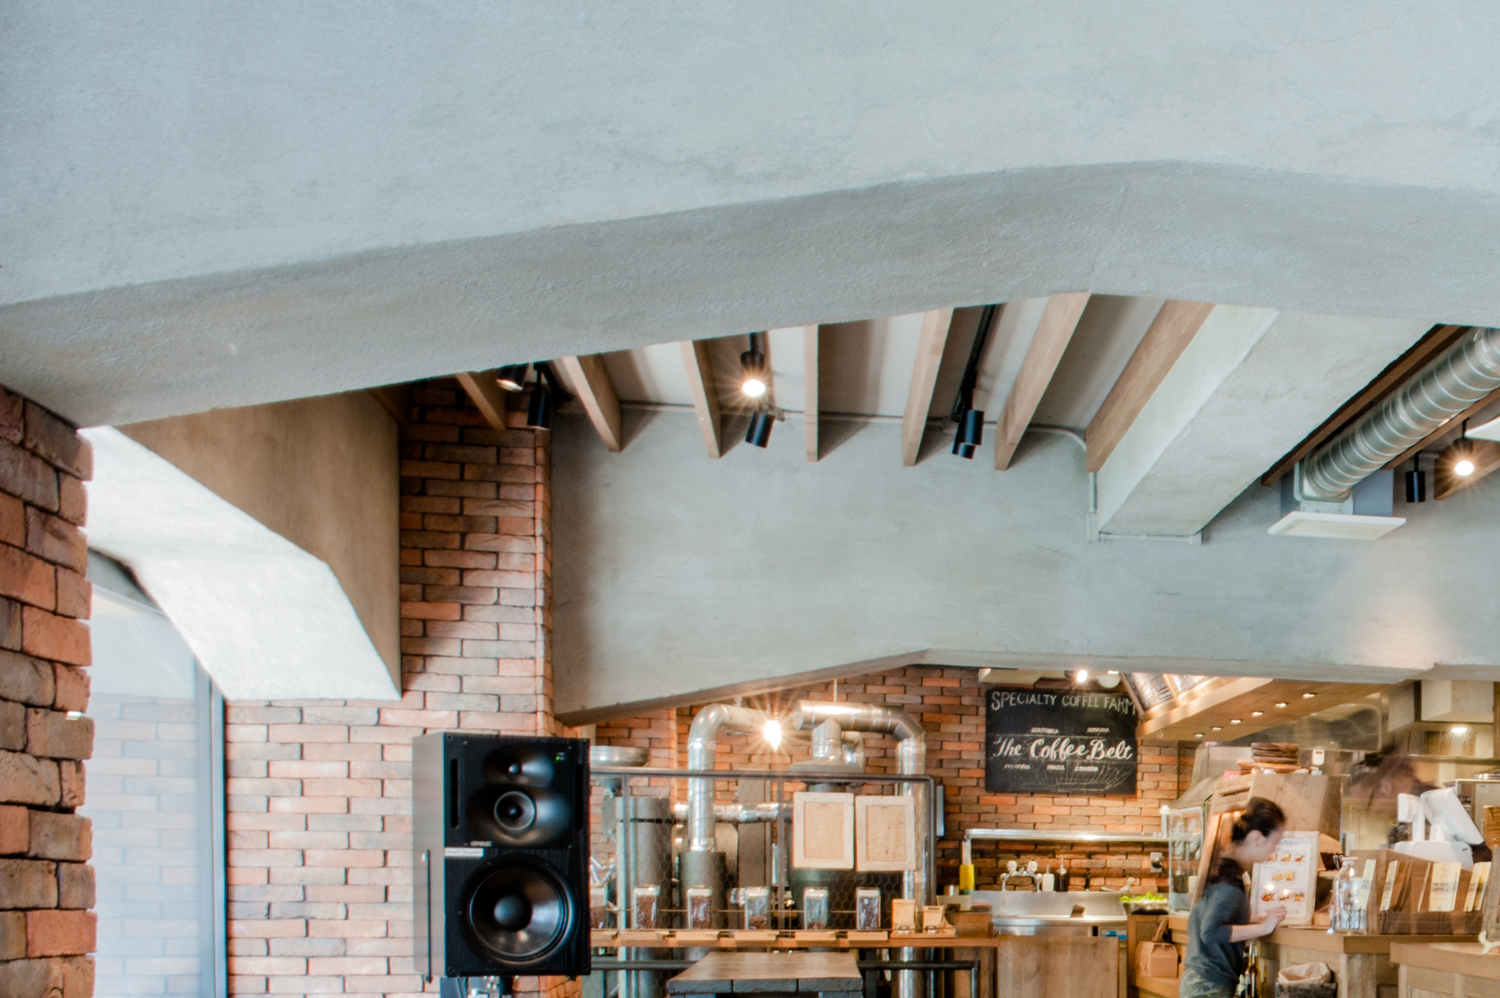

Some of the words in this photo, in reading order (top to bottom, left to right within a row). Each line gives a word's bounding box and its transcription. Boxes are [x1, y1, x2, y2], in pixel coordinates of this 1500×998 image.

[991, 691, 1057, 711] SPECIALTY
[1061, 694, 1100, 708] COFFEE
[993, 736, 1022, 757] The
[1030, 737, 1089, 762] Coffee
[1086, 739, 1133, 760] Belt
